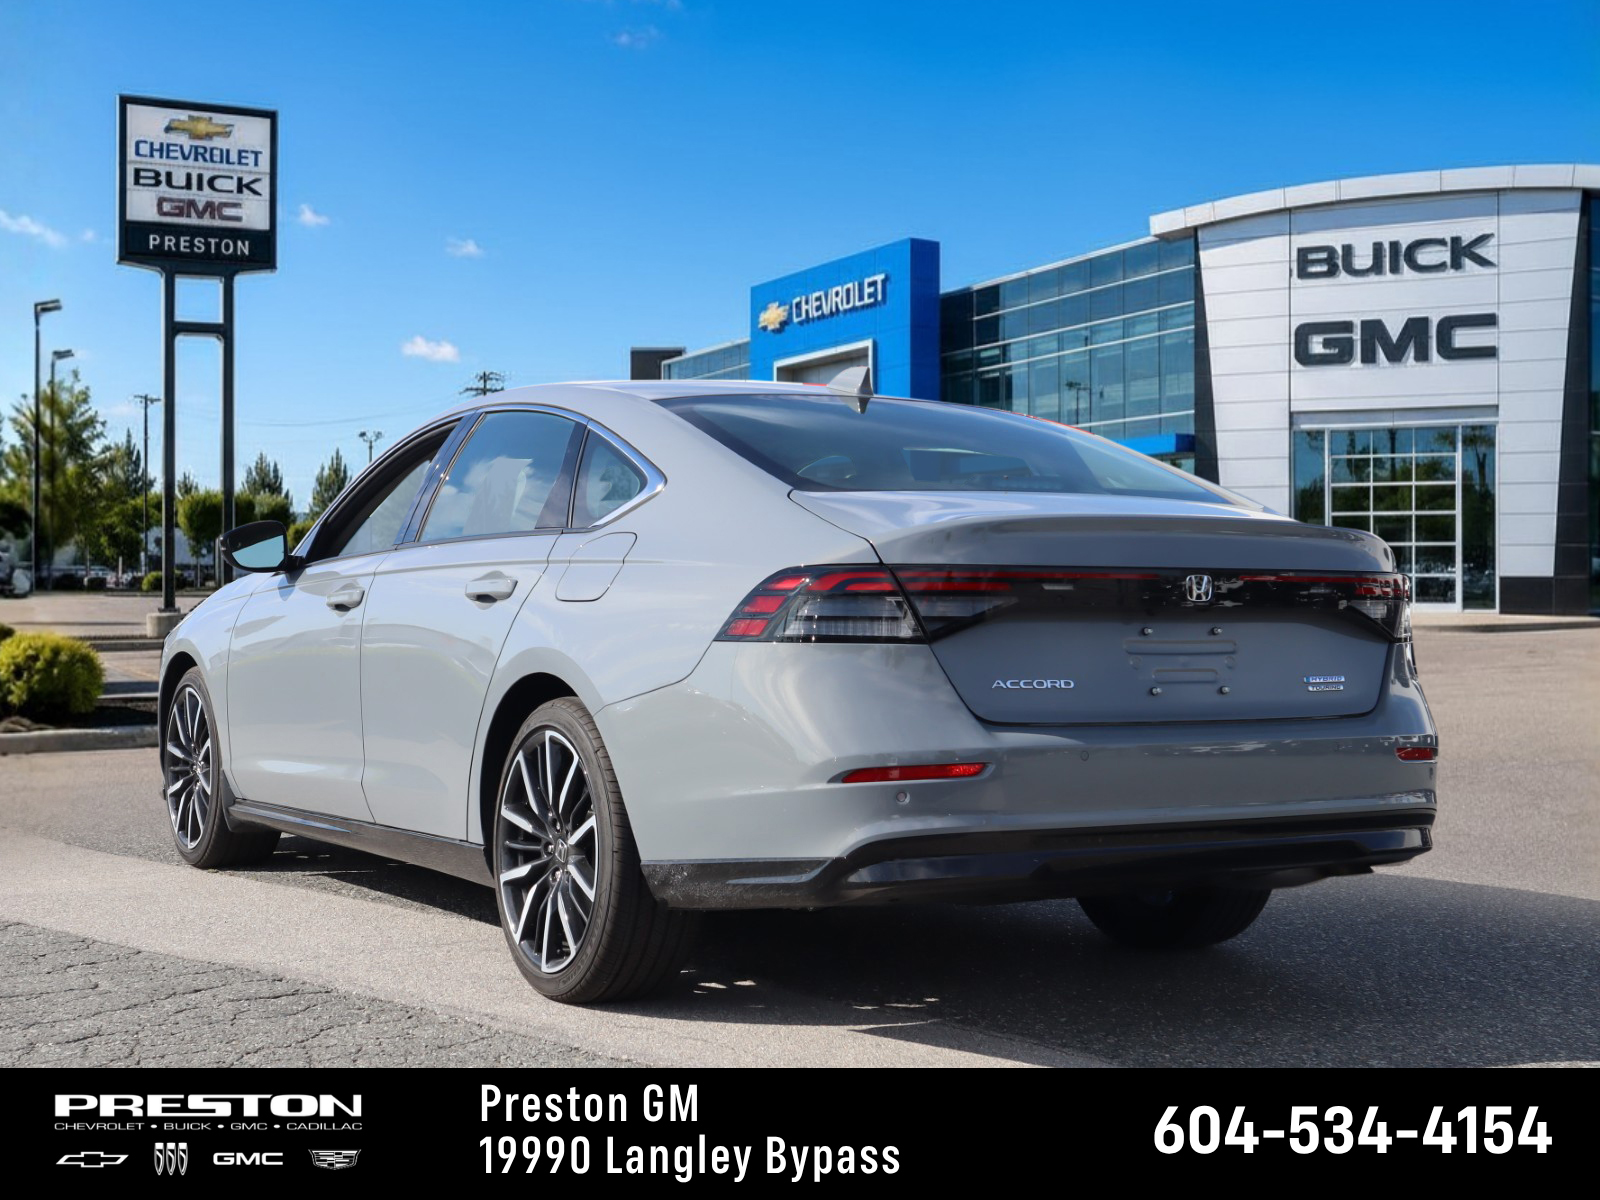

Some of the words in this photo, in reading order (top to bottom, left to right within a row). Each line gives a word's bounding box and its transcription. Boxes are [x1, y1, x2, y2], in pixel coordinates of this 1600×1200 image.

[134, 140, 263, 167] CHEVROLET
[133, 168, 263, 196] BUICK
[156, 196, 243, 222] GMC
[149, 234, 250, 256] PRESTON
[1297, 233, 1497, 280] BUICK
[792, 273, 886, 323] CHEVROLET
[1294, 312, 1497, 367] GMC
[991, 679, 1075, 689] ACCORD
